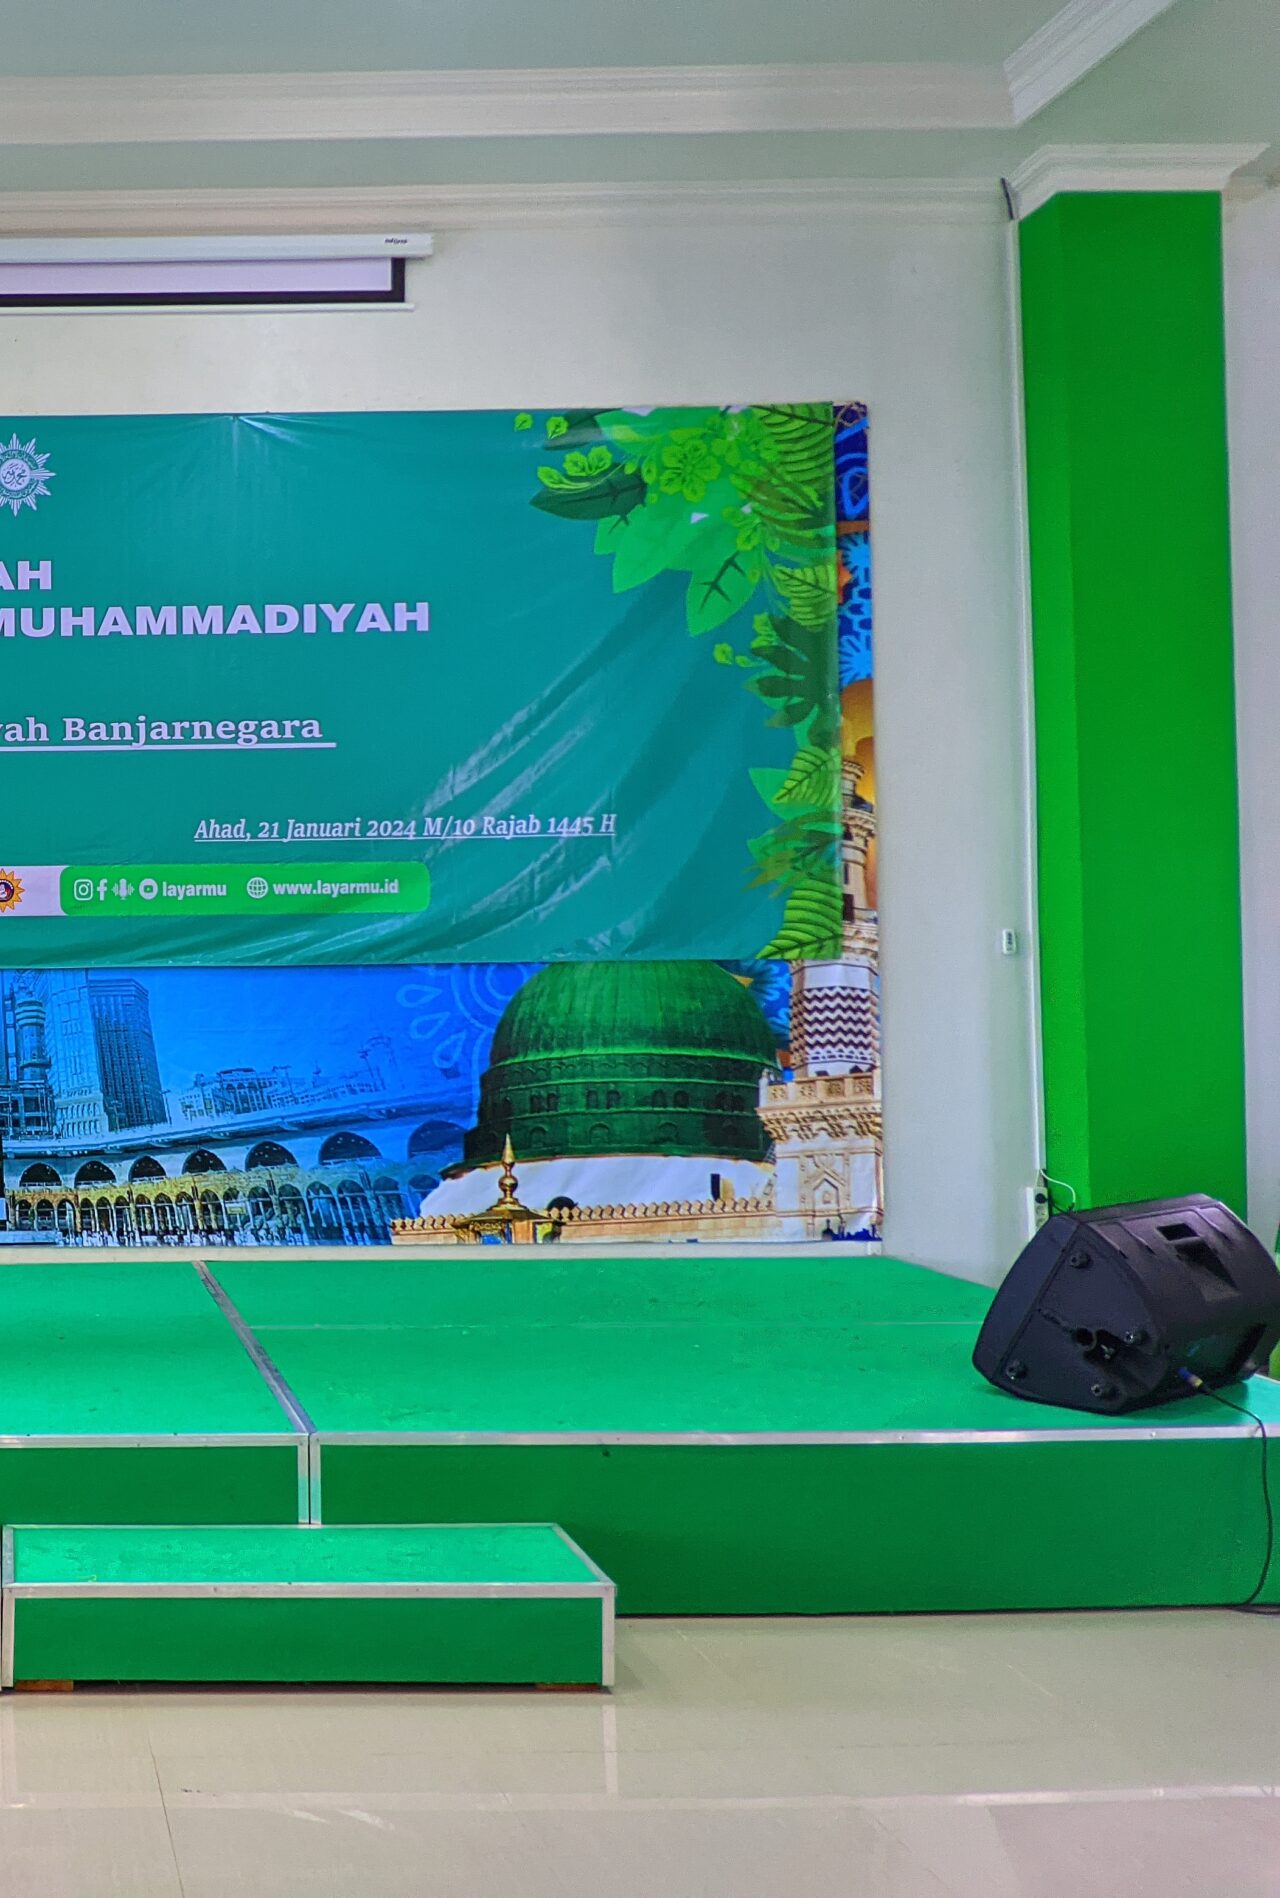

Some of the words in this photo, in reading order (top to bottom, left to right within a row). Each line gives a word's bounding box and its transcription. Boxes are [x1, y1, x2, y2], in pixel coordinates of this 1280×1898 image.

[62, 714, 323, 748] Banjarnegara
[195, 819, 251, 840] Ahad,
[258, 820, 279, 839] 21
[284, 817, 361, 842] Januari
[366, 818, 416, 839] 2024
[423, 816, 477, 837] M/10
[482, 814, 541, 839] Rajab
[547, 816, 594, 836] 1445
[599, 813, 616, 834] H
[163, 880, 227, 900] layarmu
[273, 877, 400, 898] www.layarmu.id
